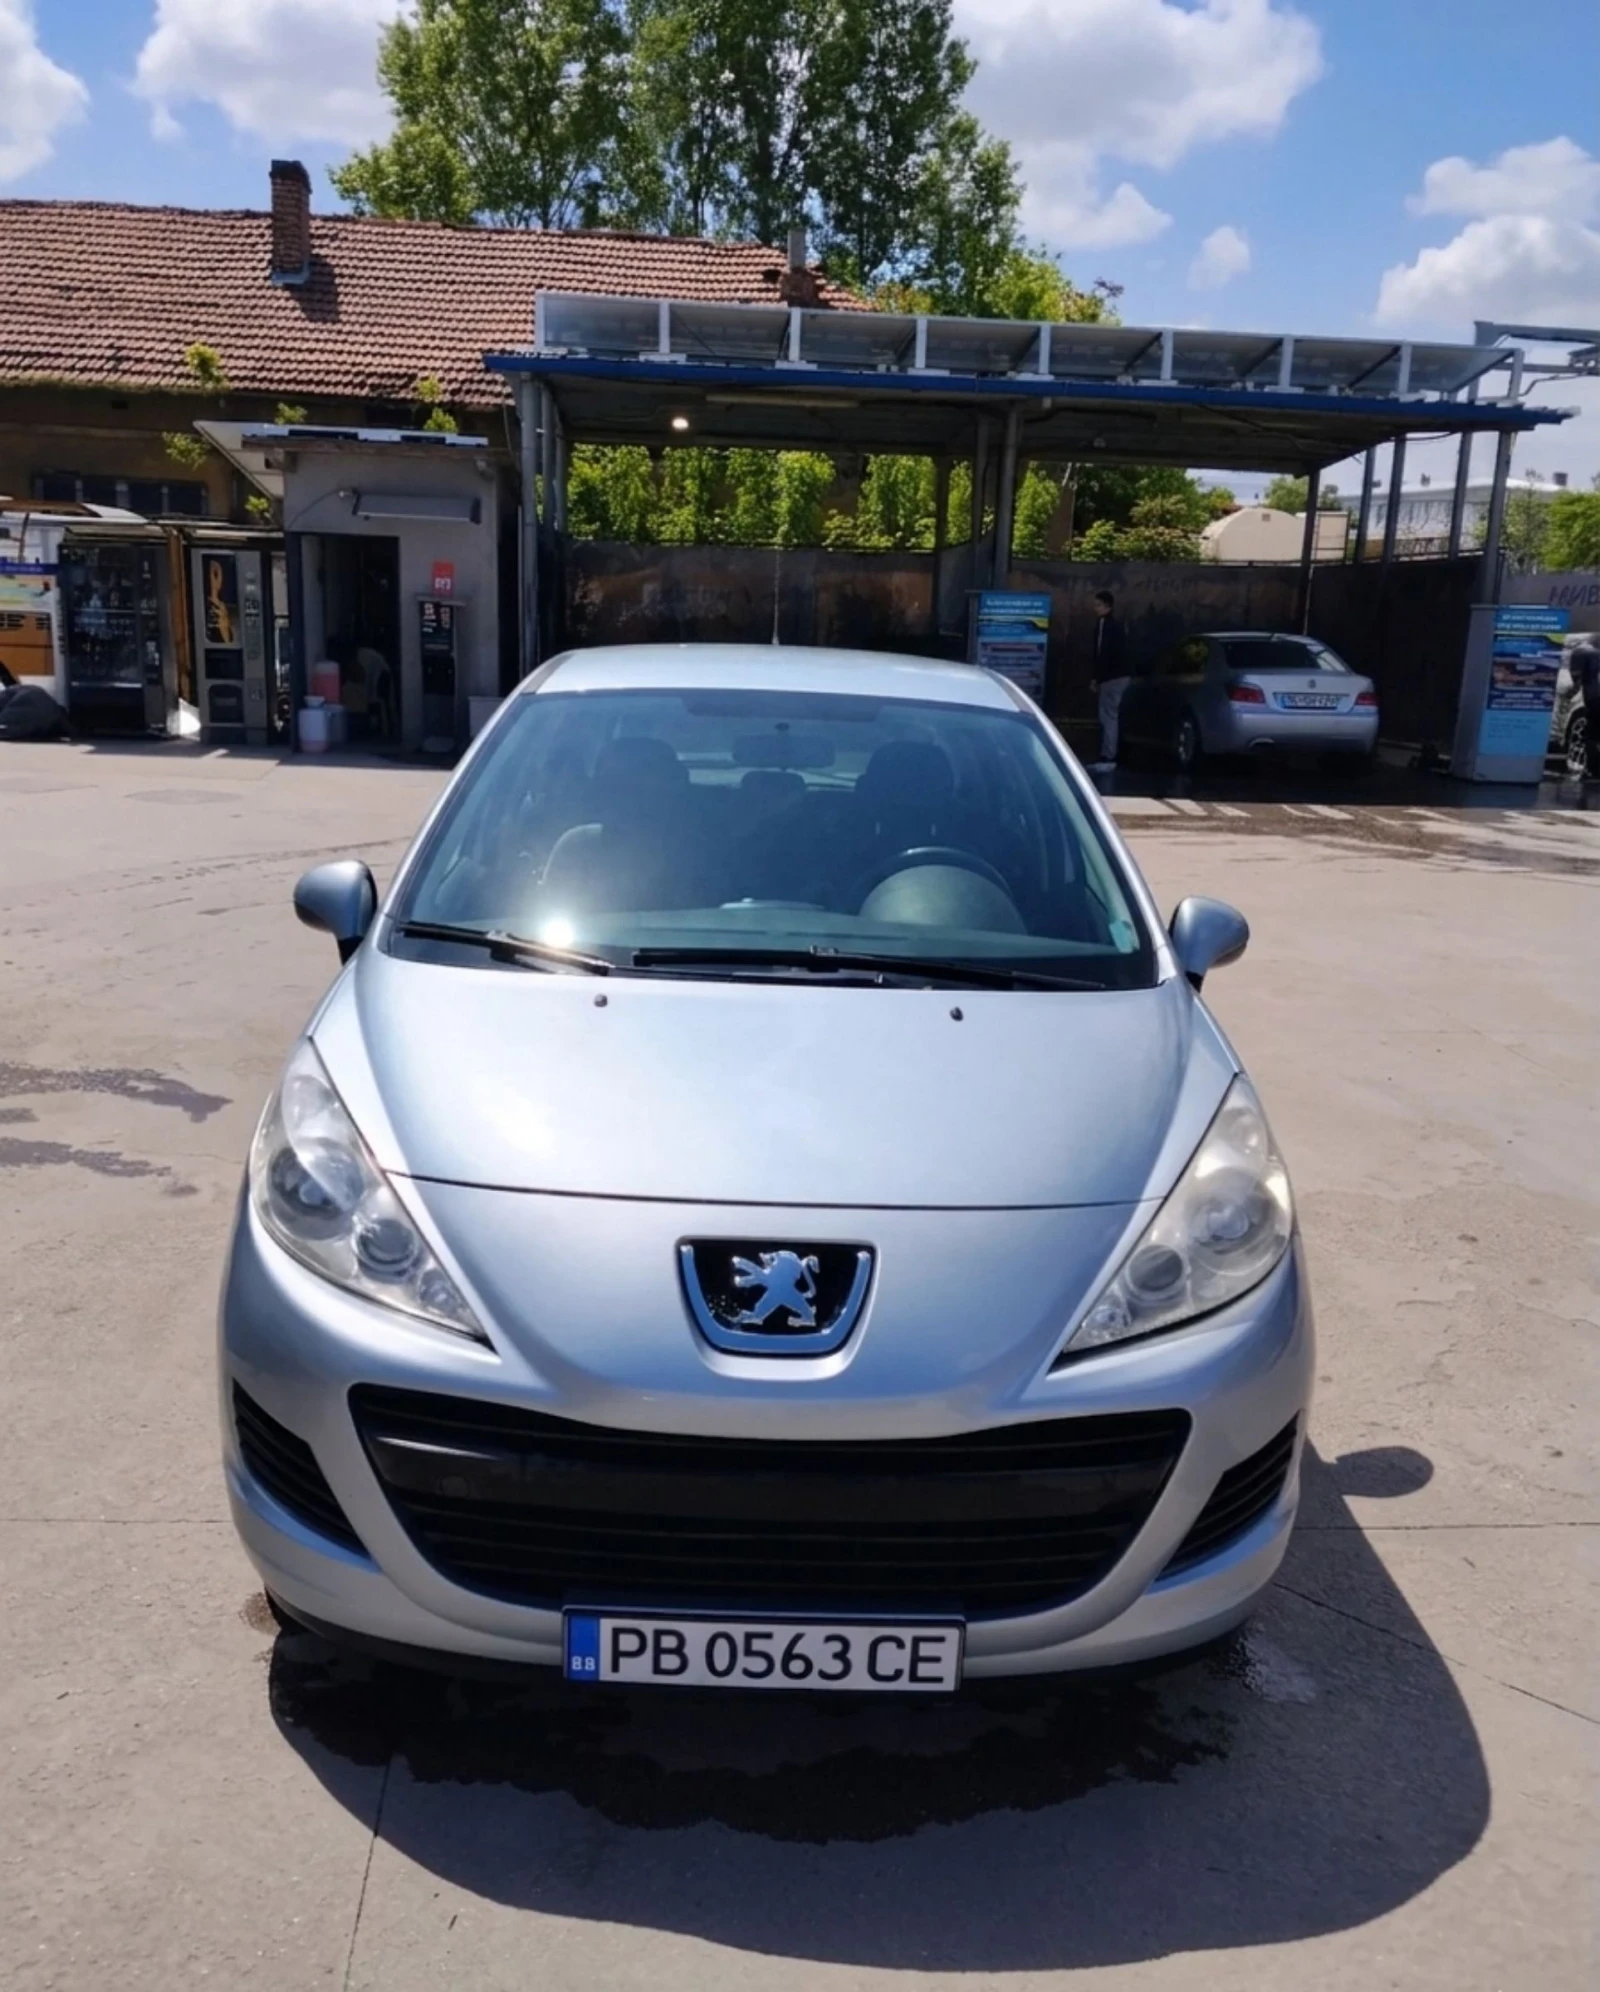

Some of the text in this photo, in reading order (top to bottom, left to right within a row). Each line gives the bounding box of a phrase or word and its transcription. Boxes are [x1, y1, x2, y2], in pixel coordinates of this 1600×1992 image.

[611, 1627, 946, 1683] PB 0563 CE
